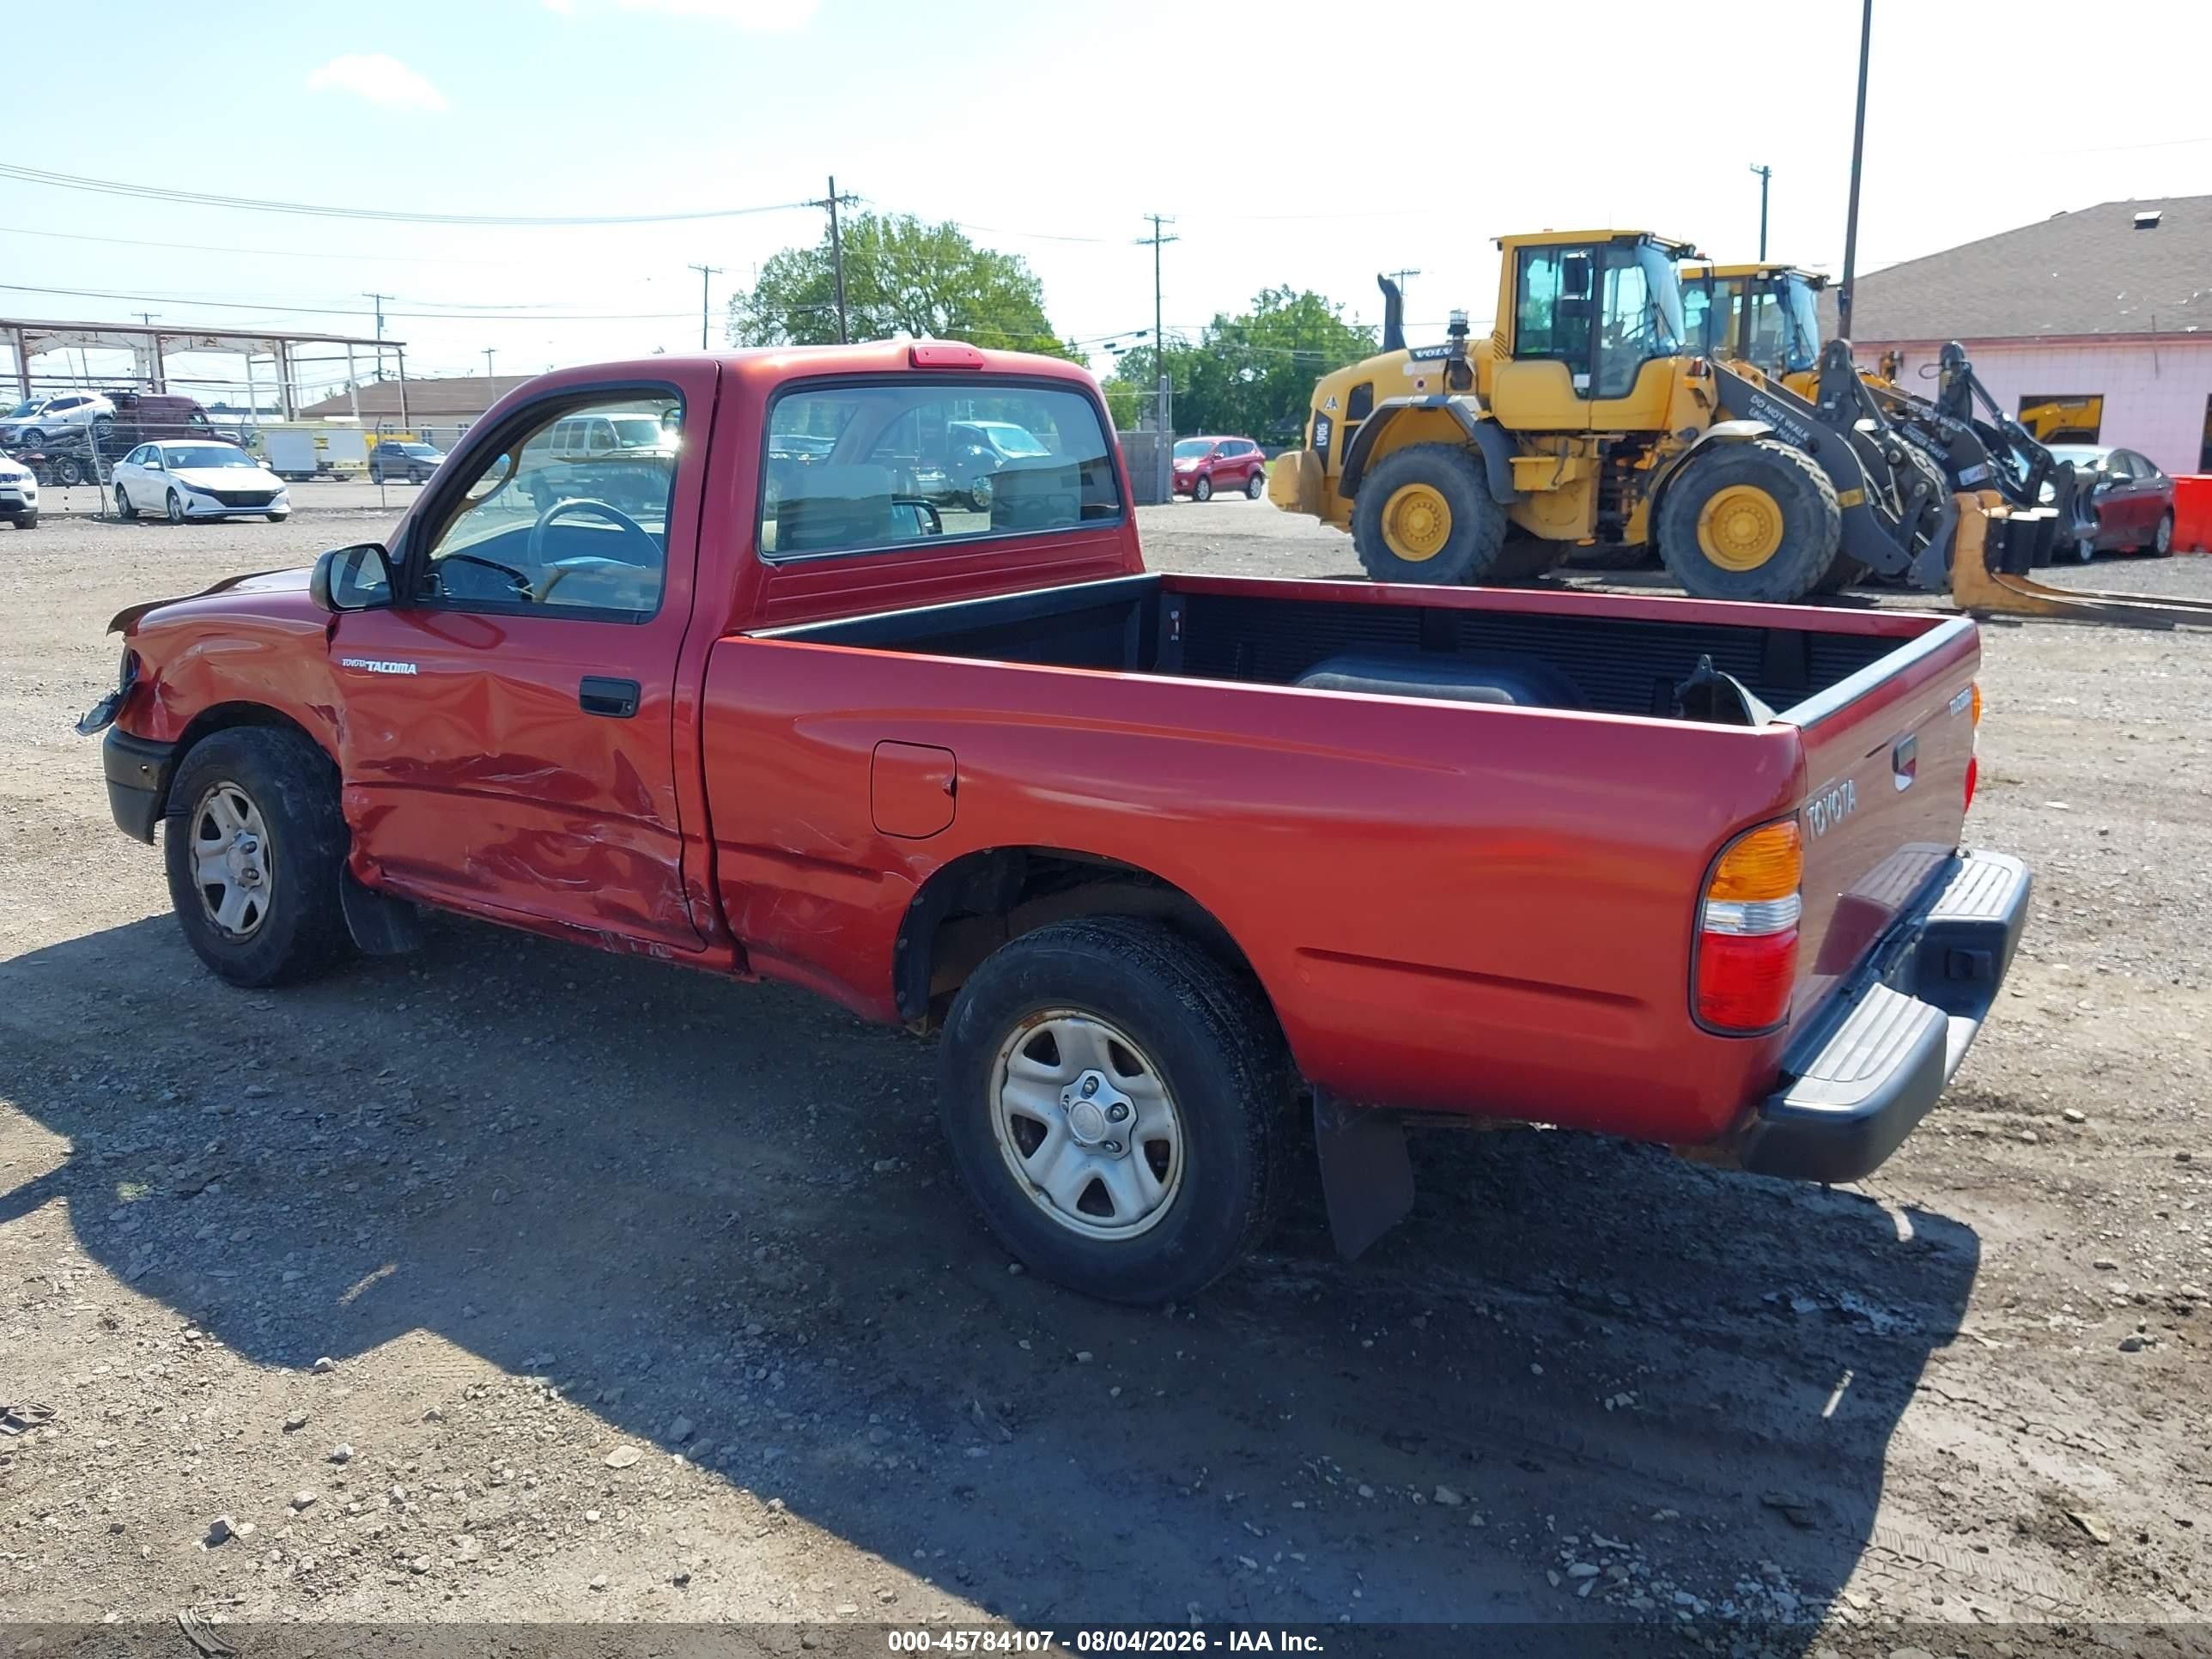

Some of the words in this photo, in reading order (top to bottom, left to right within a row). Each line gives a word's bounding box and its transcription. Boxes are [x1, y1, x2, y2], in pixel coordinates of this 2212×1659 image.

[1415, 346, 1455, 358] VOLV
[365, 660, 417, 675] TACOMA
[1806, 780, 1855, 841] TOYOTA
